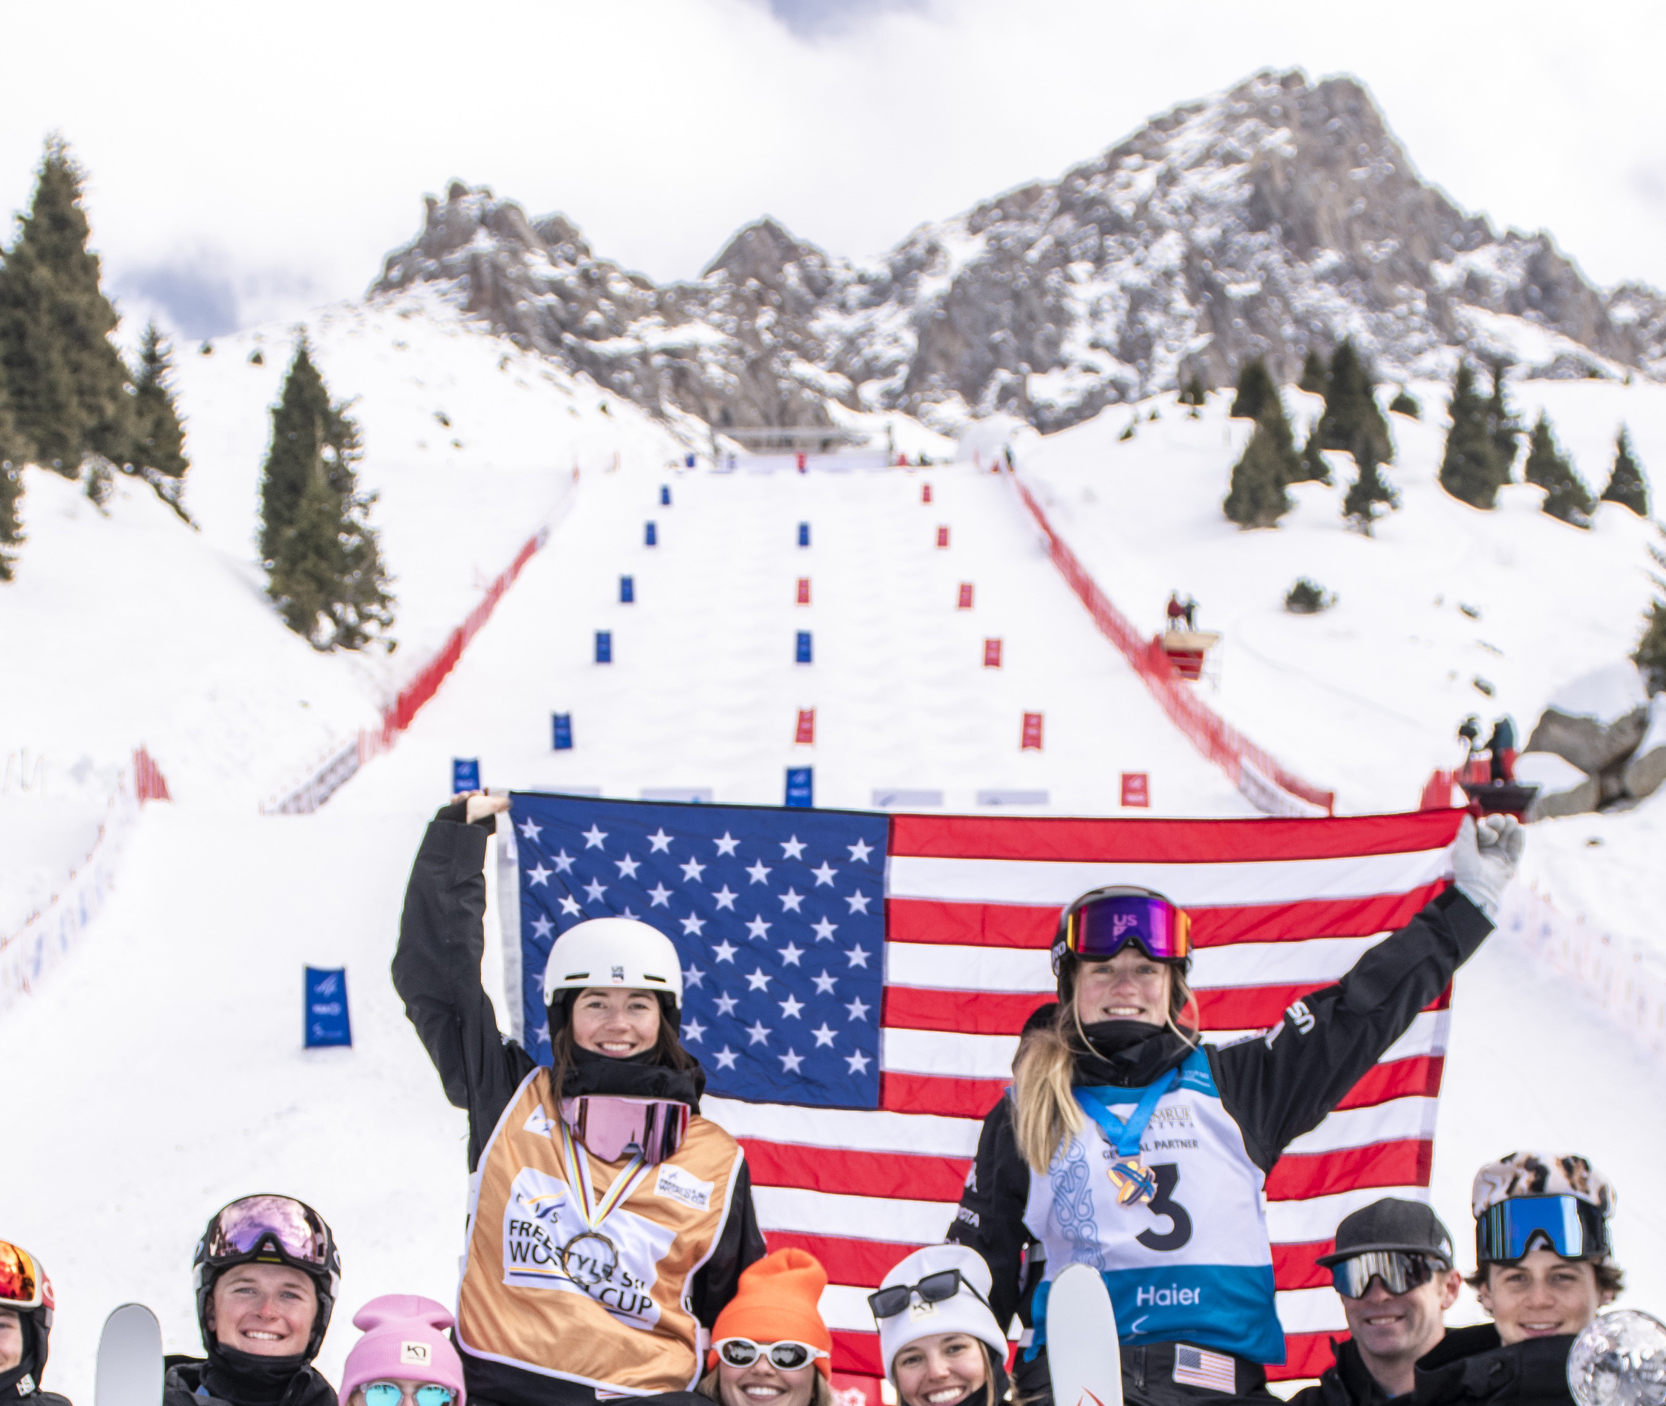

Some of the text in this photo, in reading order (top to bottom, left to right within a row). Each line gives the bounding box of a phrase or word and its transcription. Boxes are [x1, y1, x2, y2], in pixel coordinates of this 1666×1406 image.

[1153, 1139, 1199, 1150] PARTNER
[1135, 1162, 1193, 1253] 3
[599, 1287, 654, 1317] CUP
[1136, 1284, 1201, 1307] Haier
